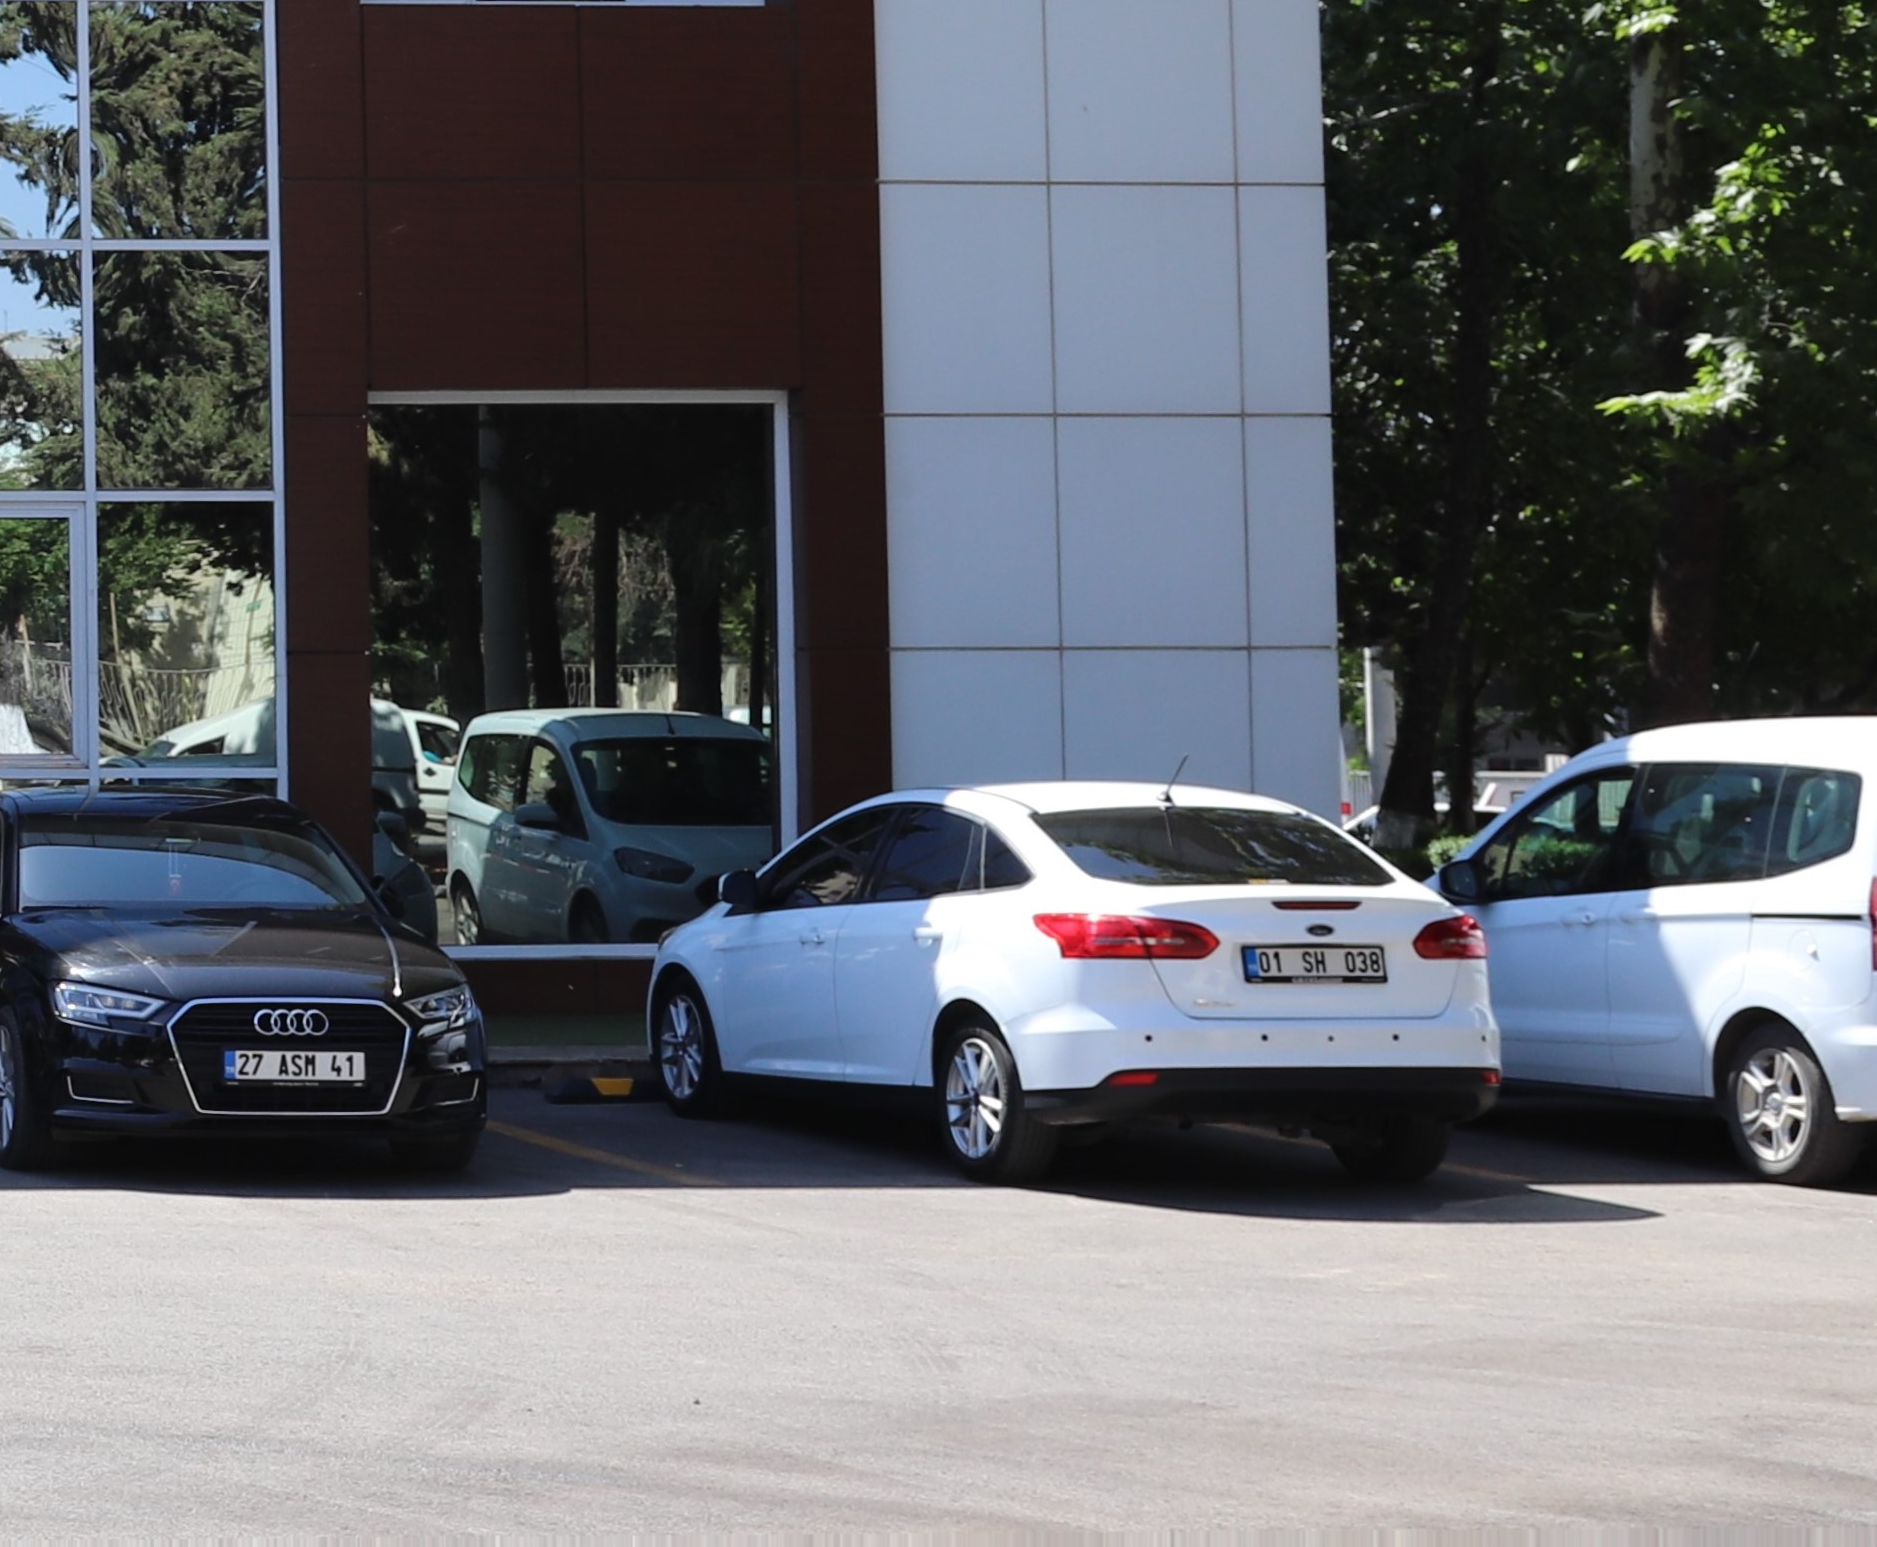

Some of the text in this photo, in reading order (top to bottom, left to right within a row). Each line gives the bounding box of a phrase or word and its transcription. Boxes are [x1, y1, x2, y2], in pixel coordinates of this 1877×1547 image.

[1259, 951, 1381, 974] 01 SH 038
[238, 1053, 355, 1077] 27 ASM 41
